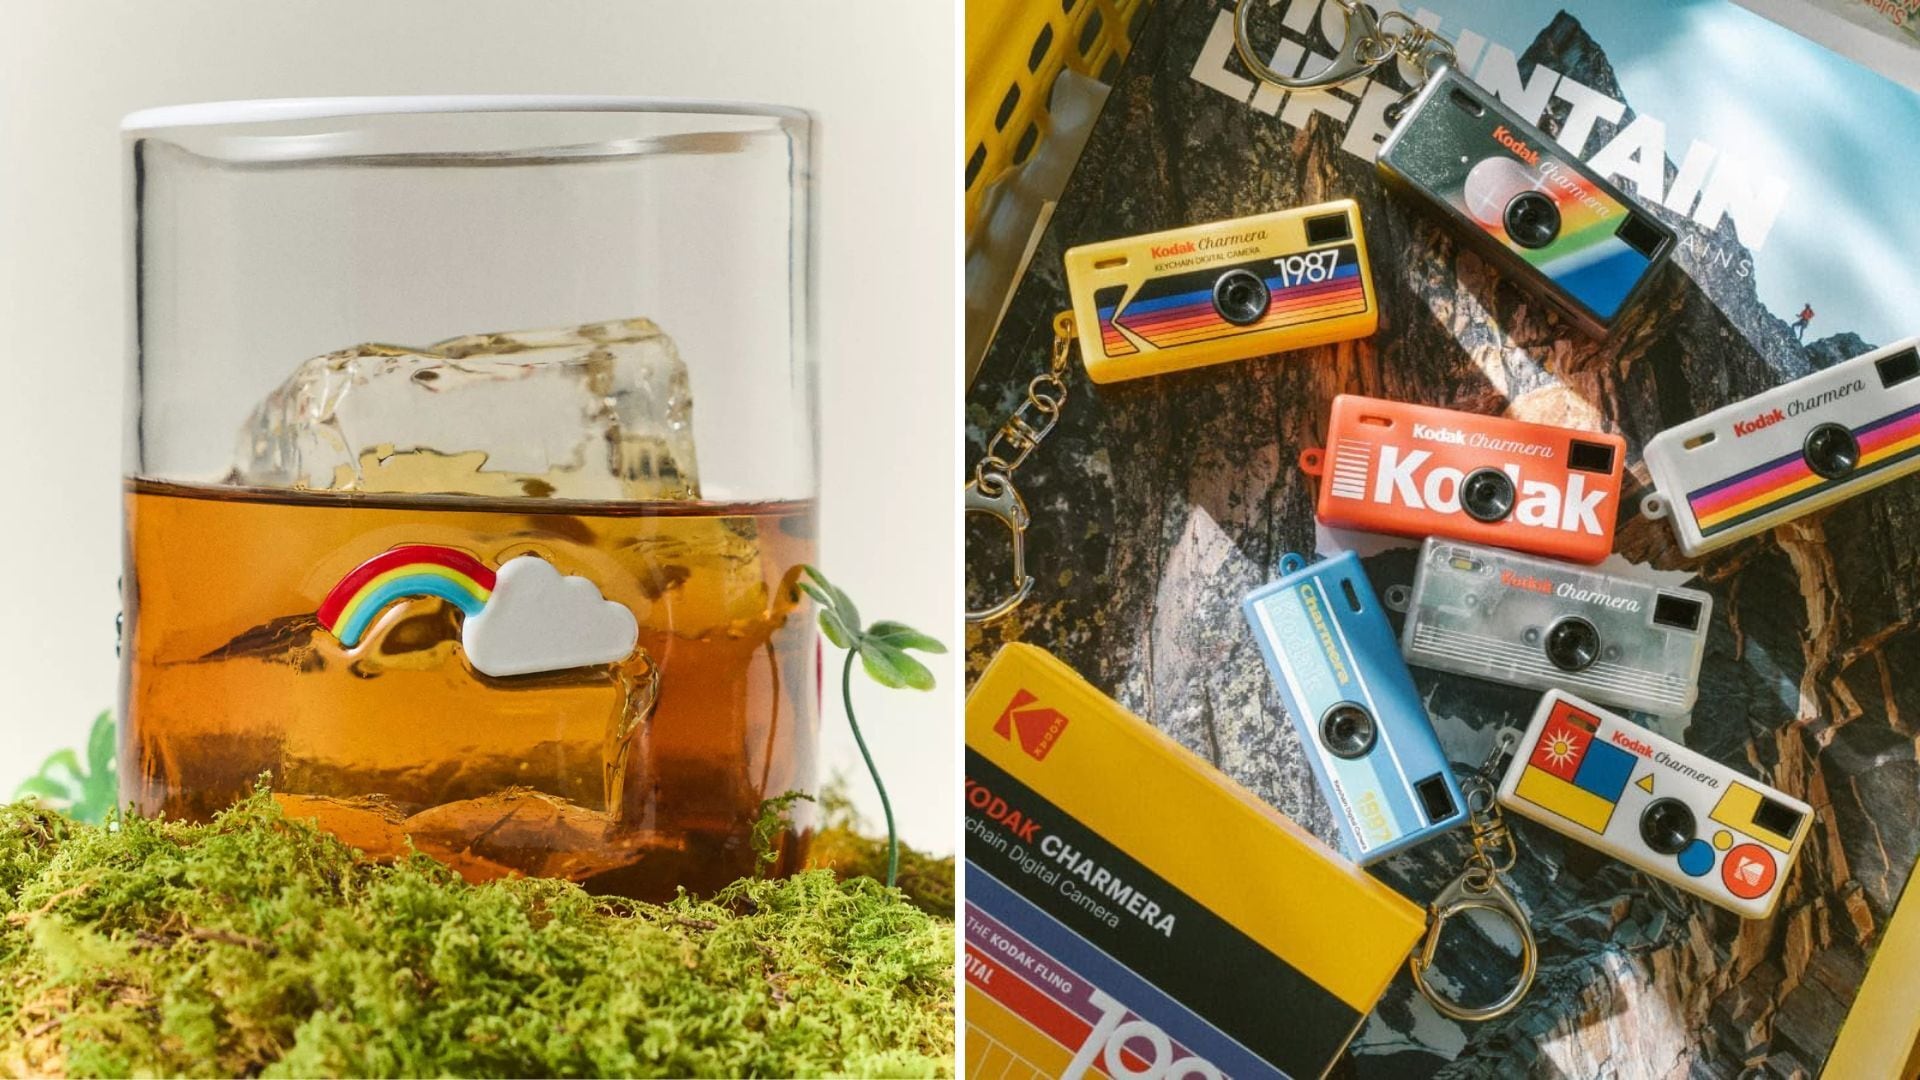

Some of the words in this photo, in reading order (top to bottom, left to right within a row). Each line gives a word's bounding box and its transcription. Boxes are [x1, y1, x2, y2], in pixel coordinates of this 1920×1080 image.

[1492, 126, 1541, 167] Kodak
[1539, 161, 1610, 217] Charmera
[1151, 241, 1196, 260] Kodak
[1197, 229, 1268, 251] Charmera
[1154, 257, 1194, 272] KEYCHAIN
[1196, 254, 1224, 265] DIGITAL
[1226, 246, 1260, 260] CAMERA
[1274, 249, 1340, 288] 1987
[1733, 407, 1787, 437] Kodak
[1786, 379, 1866, 418] Charmera
[1412, 423, 1467, 446] Kodak
[1467, 430, 1555, 458] Charmera
[1500, 568, 1555, 594] Kodak
[1555, 582, 1641, 613] Charmera
[1299, 582, 1349, 686] Charmera
[1033, 718, 1064, 757] KODAK
[1611, 729, 1655, 759] Kodak
[1654, 750, 1720, 789] Charmera
[965, 816, 1008, 853] chain
[1008, 845, 1059, 886] Digital
[1059, 880, 1119, 929] Camera
[1041, 834, 1177, 938] CHARMERA
[966, 916, 991, 939] THE
[990, 933, 1036, 969] KODAK
[1034, 963, 1073, 993] FLING
